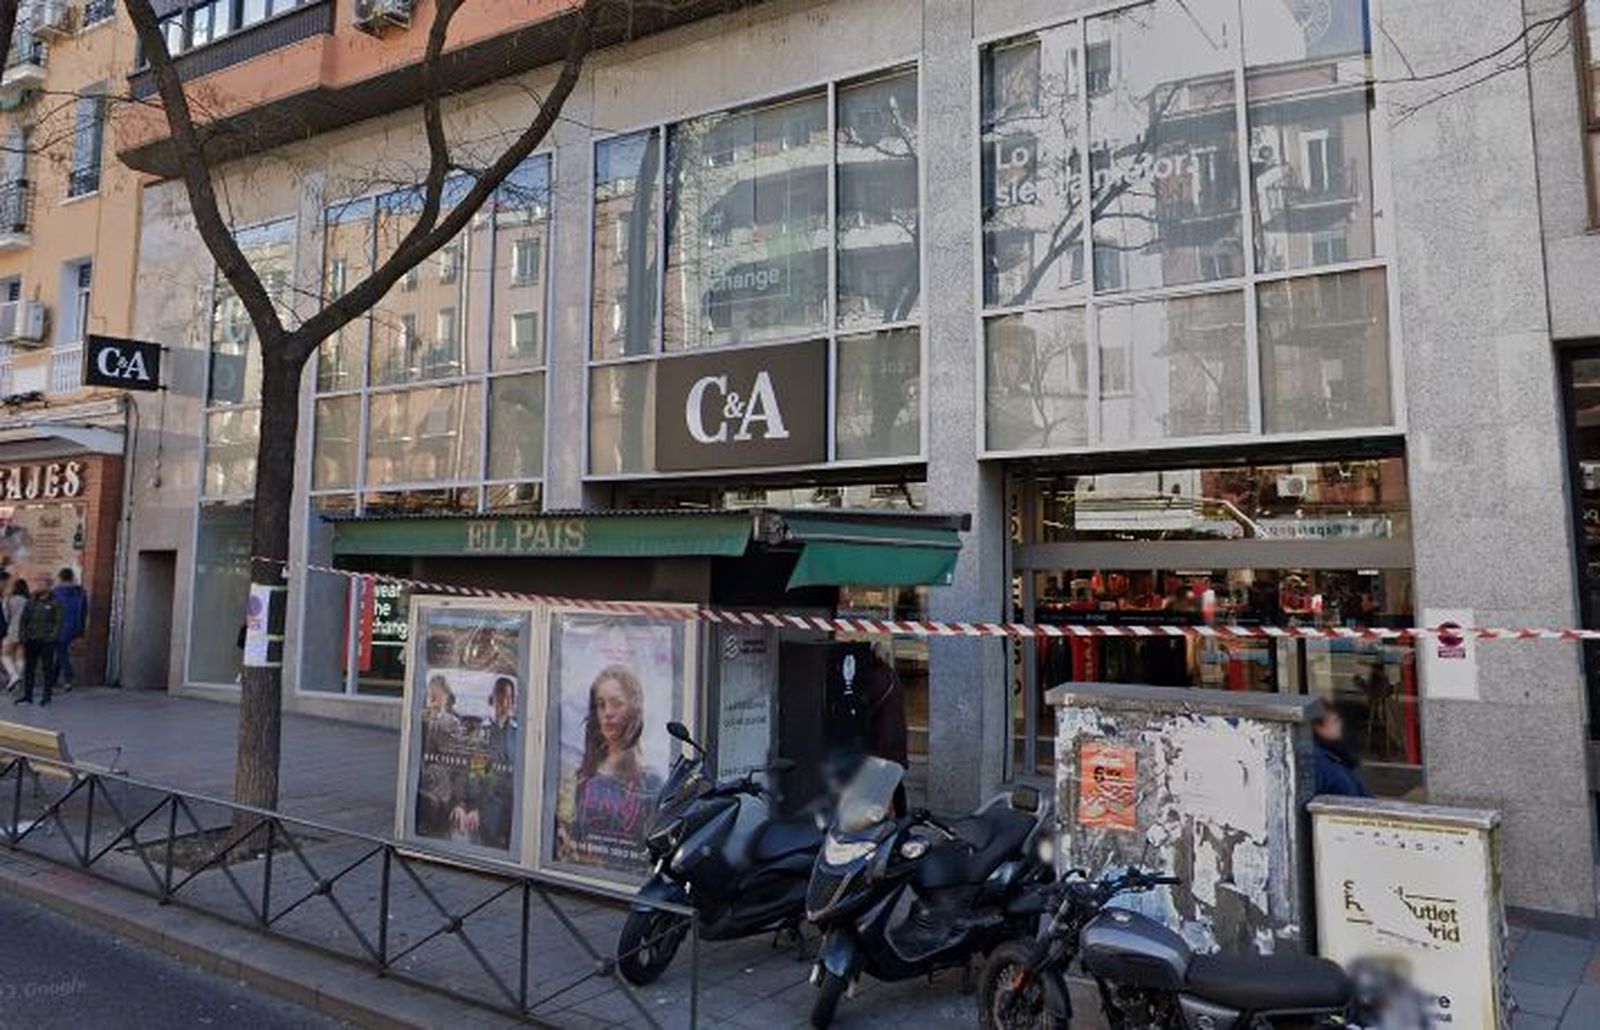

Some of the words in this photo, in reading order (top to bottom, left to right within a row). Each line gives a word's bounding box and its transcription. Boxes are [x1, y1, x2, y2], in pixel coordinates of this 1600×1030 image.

[97, 347, 150, 381] C&A
[686, 371, 790, 443] C&A
[0, 461, 80, 499] AJES
[465, 520, 507, 550] EL
[1412, 903, 1458, 924] utlet
